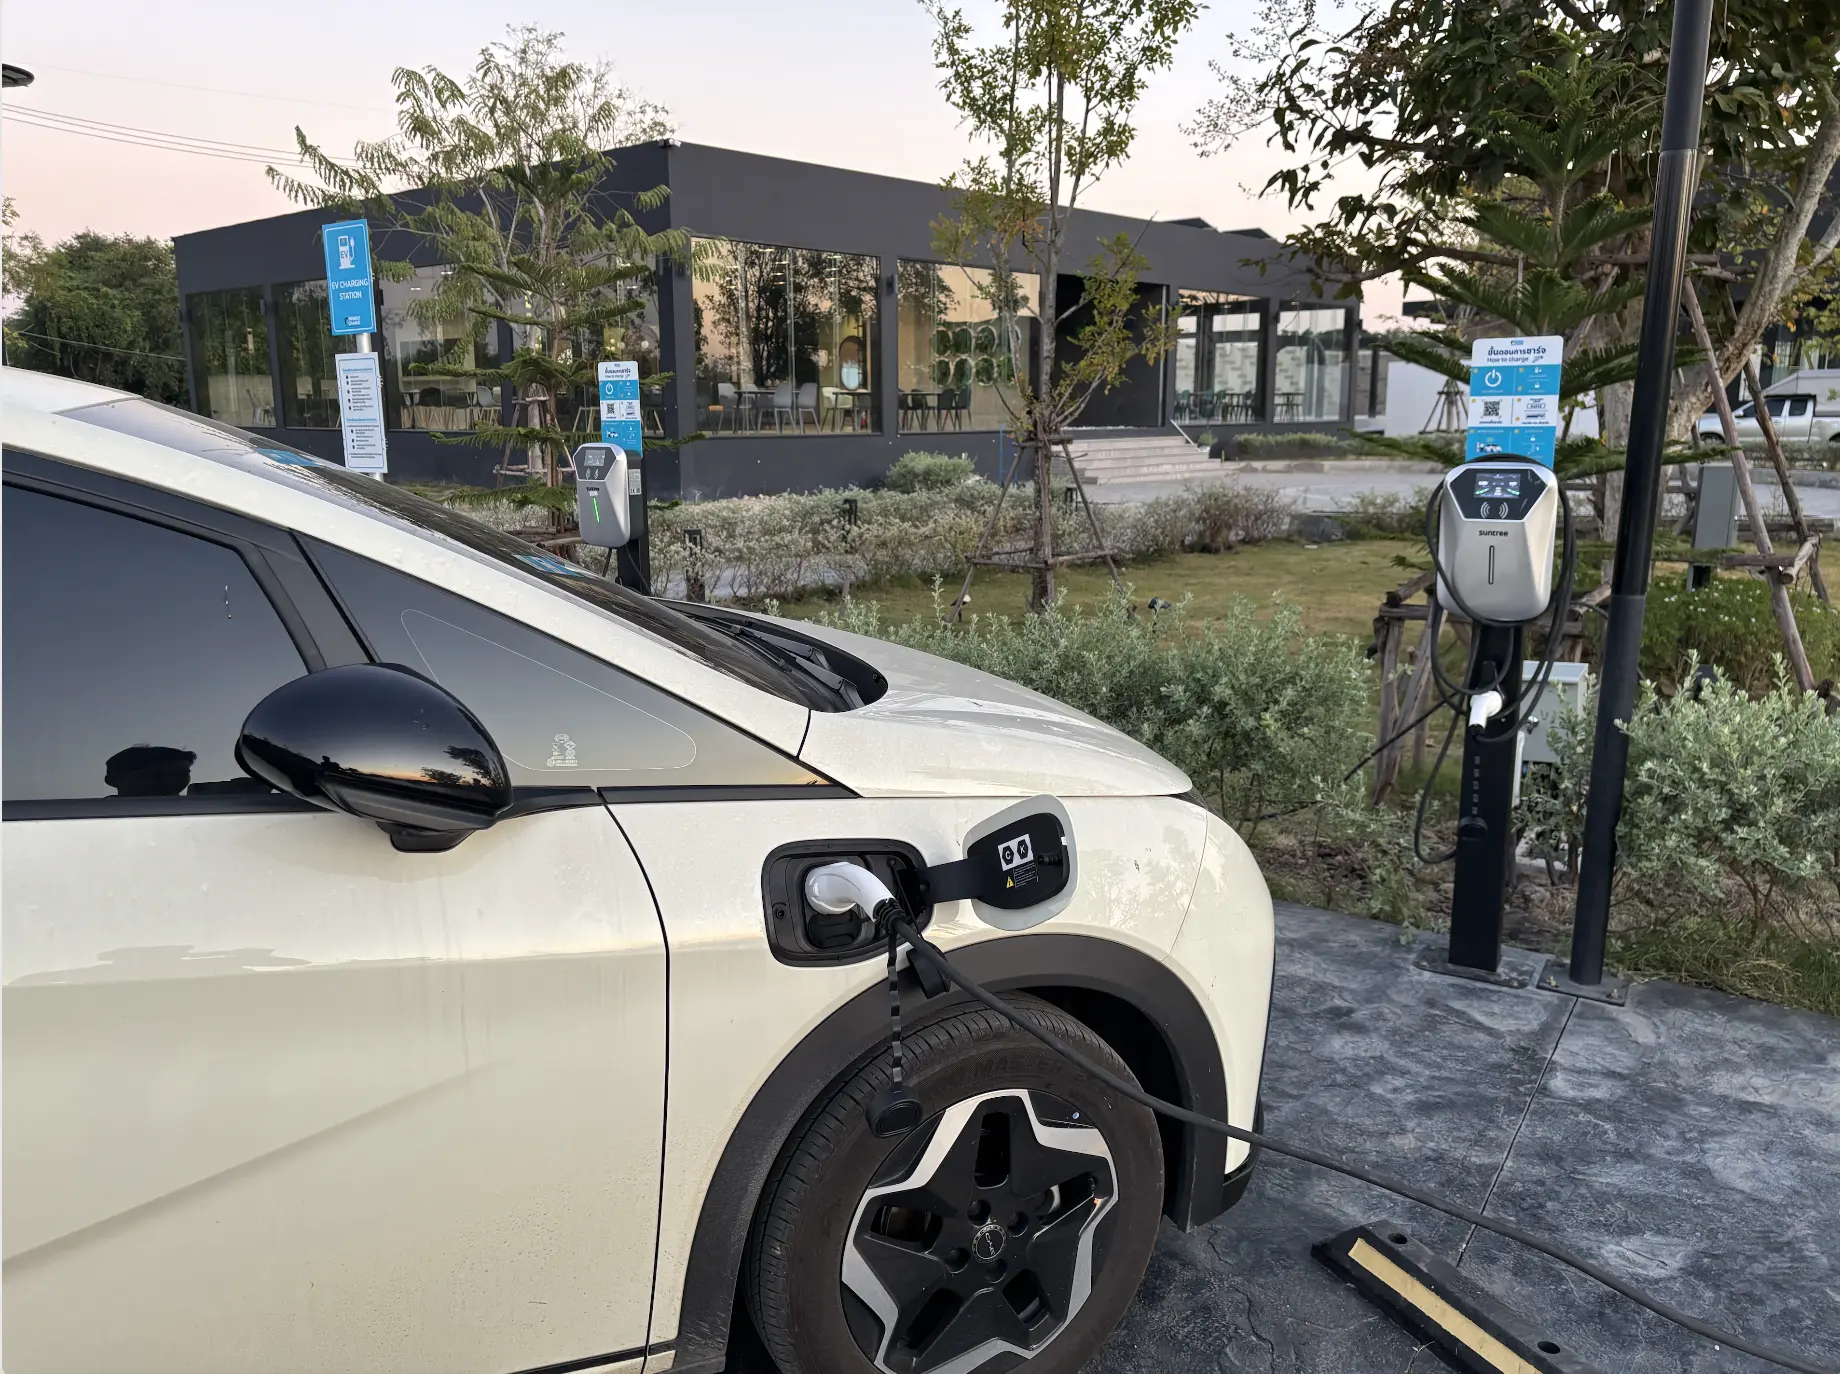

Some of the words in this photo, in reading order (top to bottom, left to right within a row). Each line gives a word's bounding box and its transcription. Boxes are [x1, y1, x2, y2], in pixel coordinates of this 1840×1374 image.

[341, 250, 348, 258] EV
[331, 281, 339, 289] EV
[340, 278, 369, 288] CHARGING
[339, 291, 362, 300] STATION
[1019, 844, 1026, 855] K
